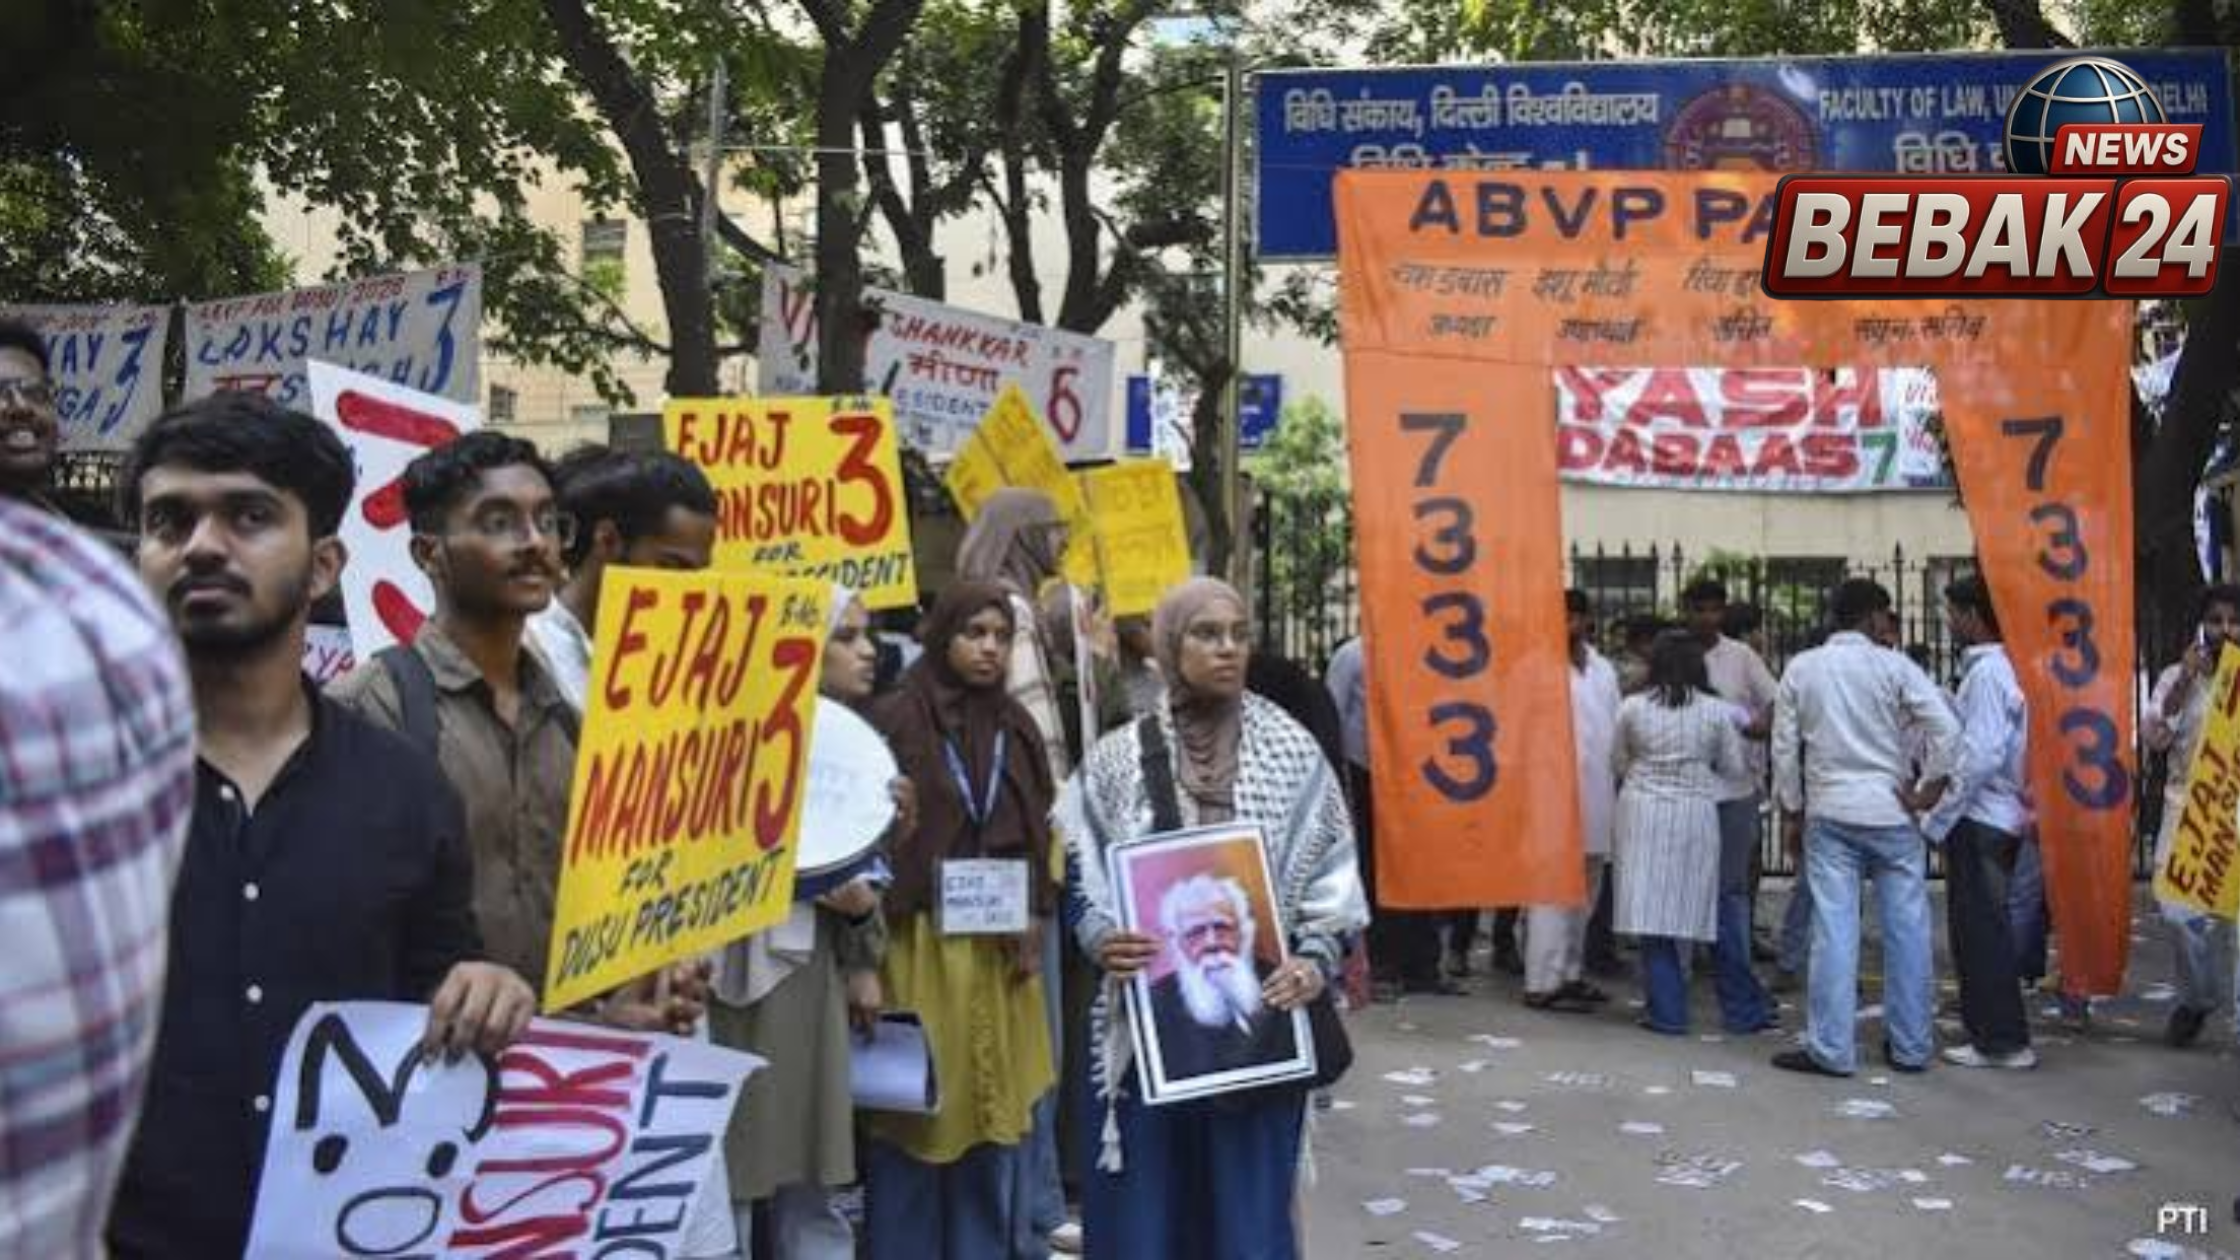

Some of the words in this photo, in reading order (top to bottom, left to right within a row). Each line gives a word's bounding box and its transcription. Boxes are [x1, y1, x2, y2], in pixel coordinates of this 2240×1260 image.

[1284, 88, 1336, 132] विधि
[1341, 87, 1424, 138] संकाय,
[1430, 84, 1500, 130] दिल्ली
[1506, 82, 1660, 127] विश्वविद्यालय
[1818, 88, 1901, 122] FACULTY
[1910, 86, 1934, 119] OF
[1943, 86, 1992, 122] LAW,
[1408, 178, 1665, 241] ABVP
[1048, 366, 1082, 444] 6
[1555, 366, 1883, 429] YASH
[828, 413, 894, 547] 3
[1399, 412, 1467, 488] 7
[1862, 431, 1899, 485] 7
[2002, 415, 2064, 491] 7
[712, 474, 839, 544] ANSURI
[1413, 497, 1477, 576] 3
[2030, 501, 2088, 583] 3
[1421, 591, 1492, 681] 3
[2047, 597, 2099, 689] 3
[605, 585, 769, 711] EJAJ
[755, 637, 818, 851] 3
[1420, 702, 1499, 803] 3
[570, 717, 761, 870] MANSURI
[2060, 708, 2129, 811] 3
[619, 849, 675, 894] FOR
[555, 904, 632, 988] DUSU
[629, 845, 787, 949] PRESIDENT
